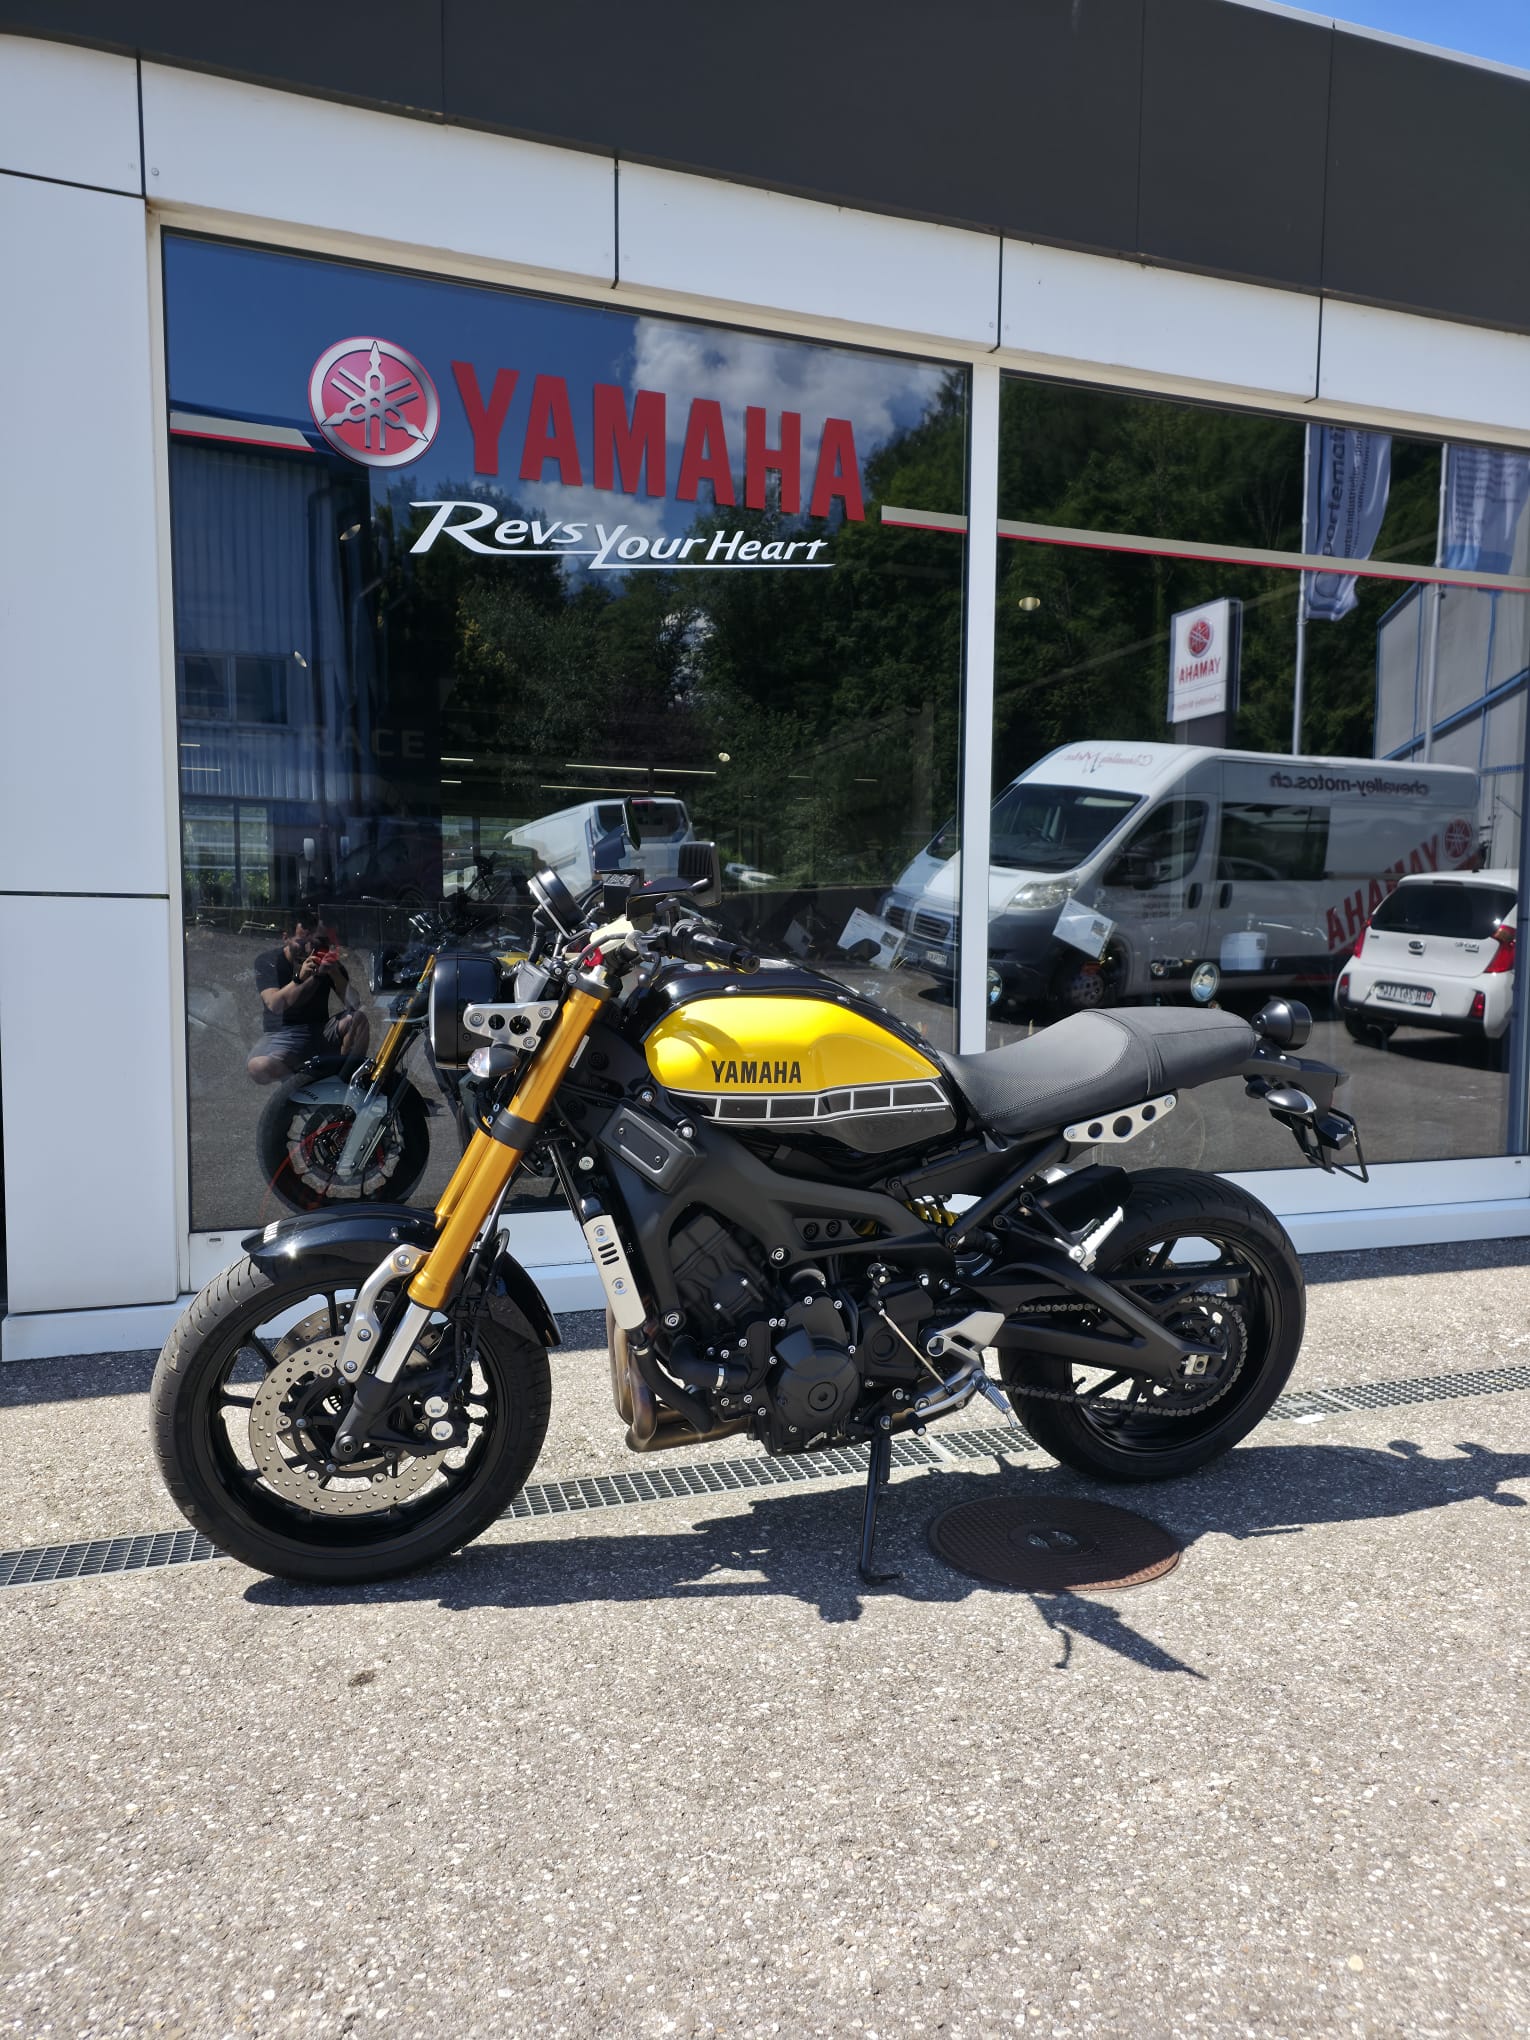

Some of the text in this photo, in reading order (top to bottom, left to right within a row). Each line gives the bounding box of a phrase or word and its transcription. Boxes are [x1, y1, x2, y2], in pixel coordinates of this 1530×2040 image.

[452, 360, 866, 522] YAMAHA
[409, 502, 829, 569] Revs Your Heart
[711, 1060, 802, 1084] YAMAHA
